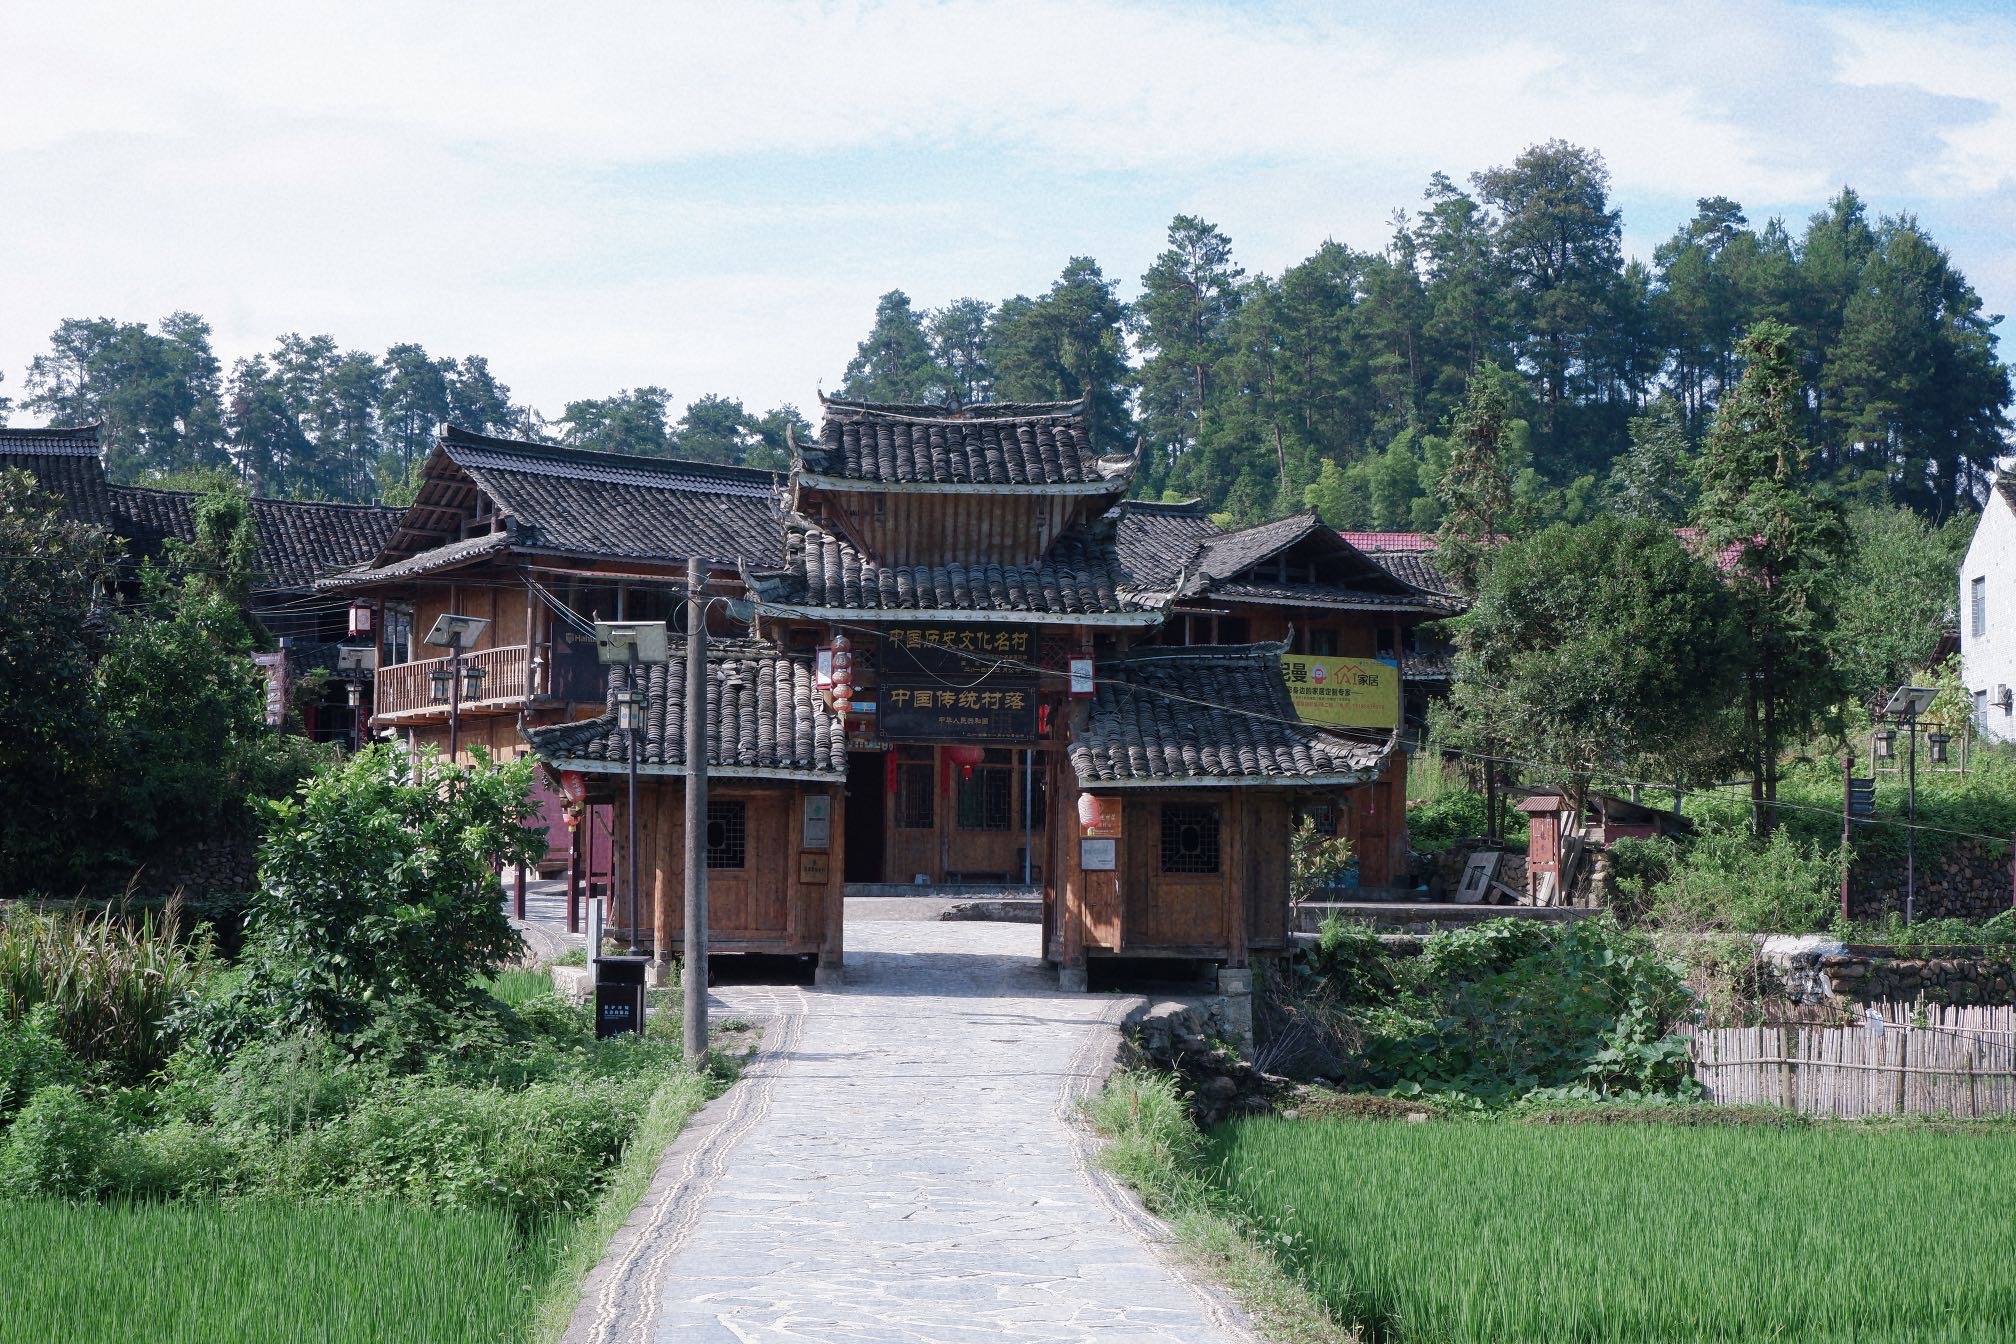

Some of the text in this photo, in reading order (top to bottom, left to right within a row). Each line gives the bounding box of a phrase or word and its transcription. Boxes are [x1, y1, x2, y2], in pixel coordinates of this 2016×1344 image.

[888, 629, 1029, 651] 中国历史文化名村
[890, 689, 1025, 710] 中国传统村落
